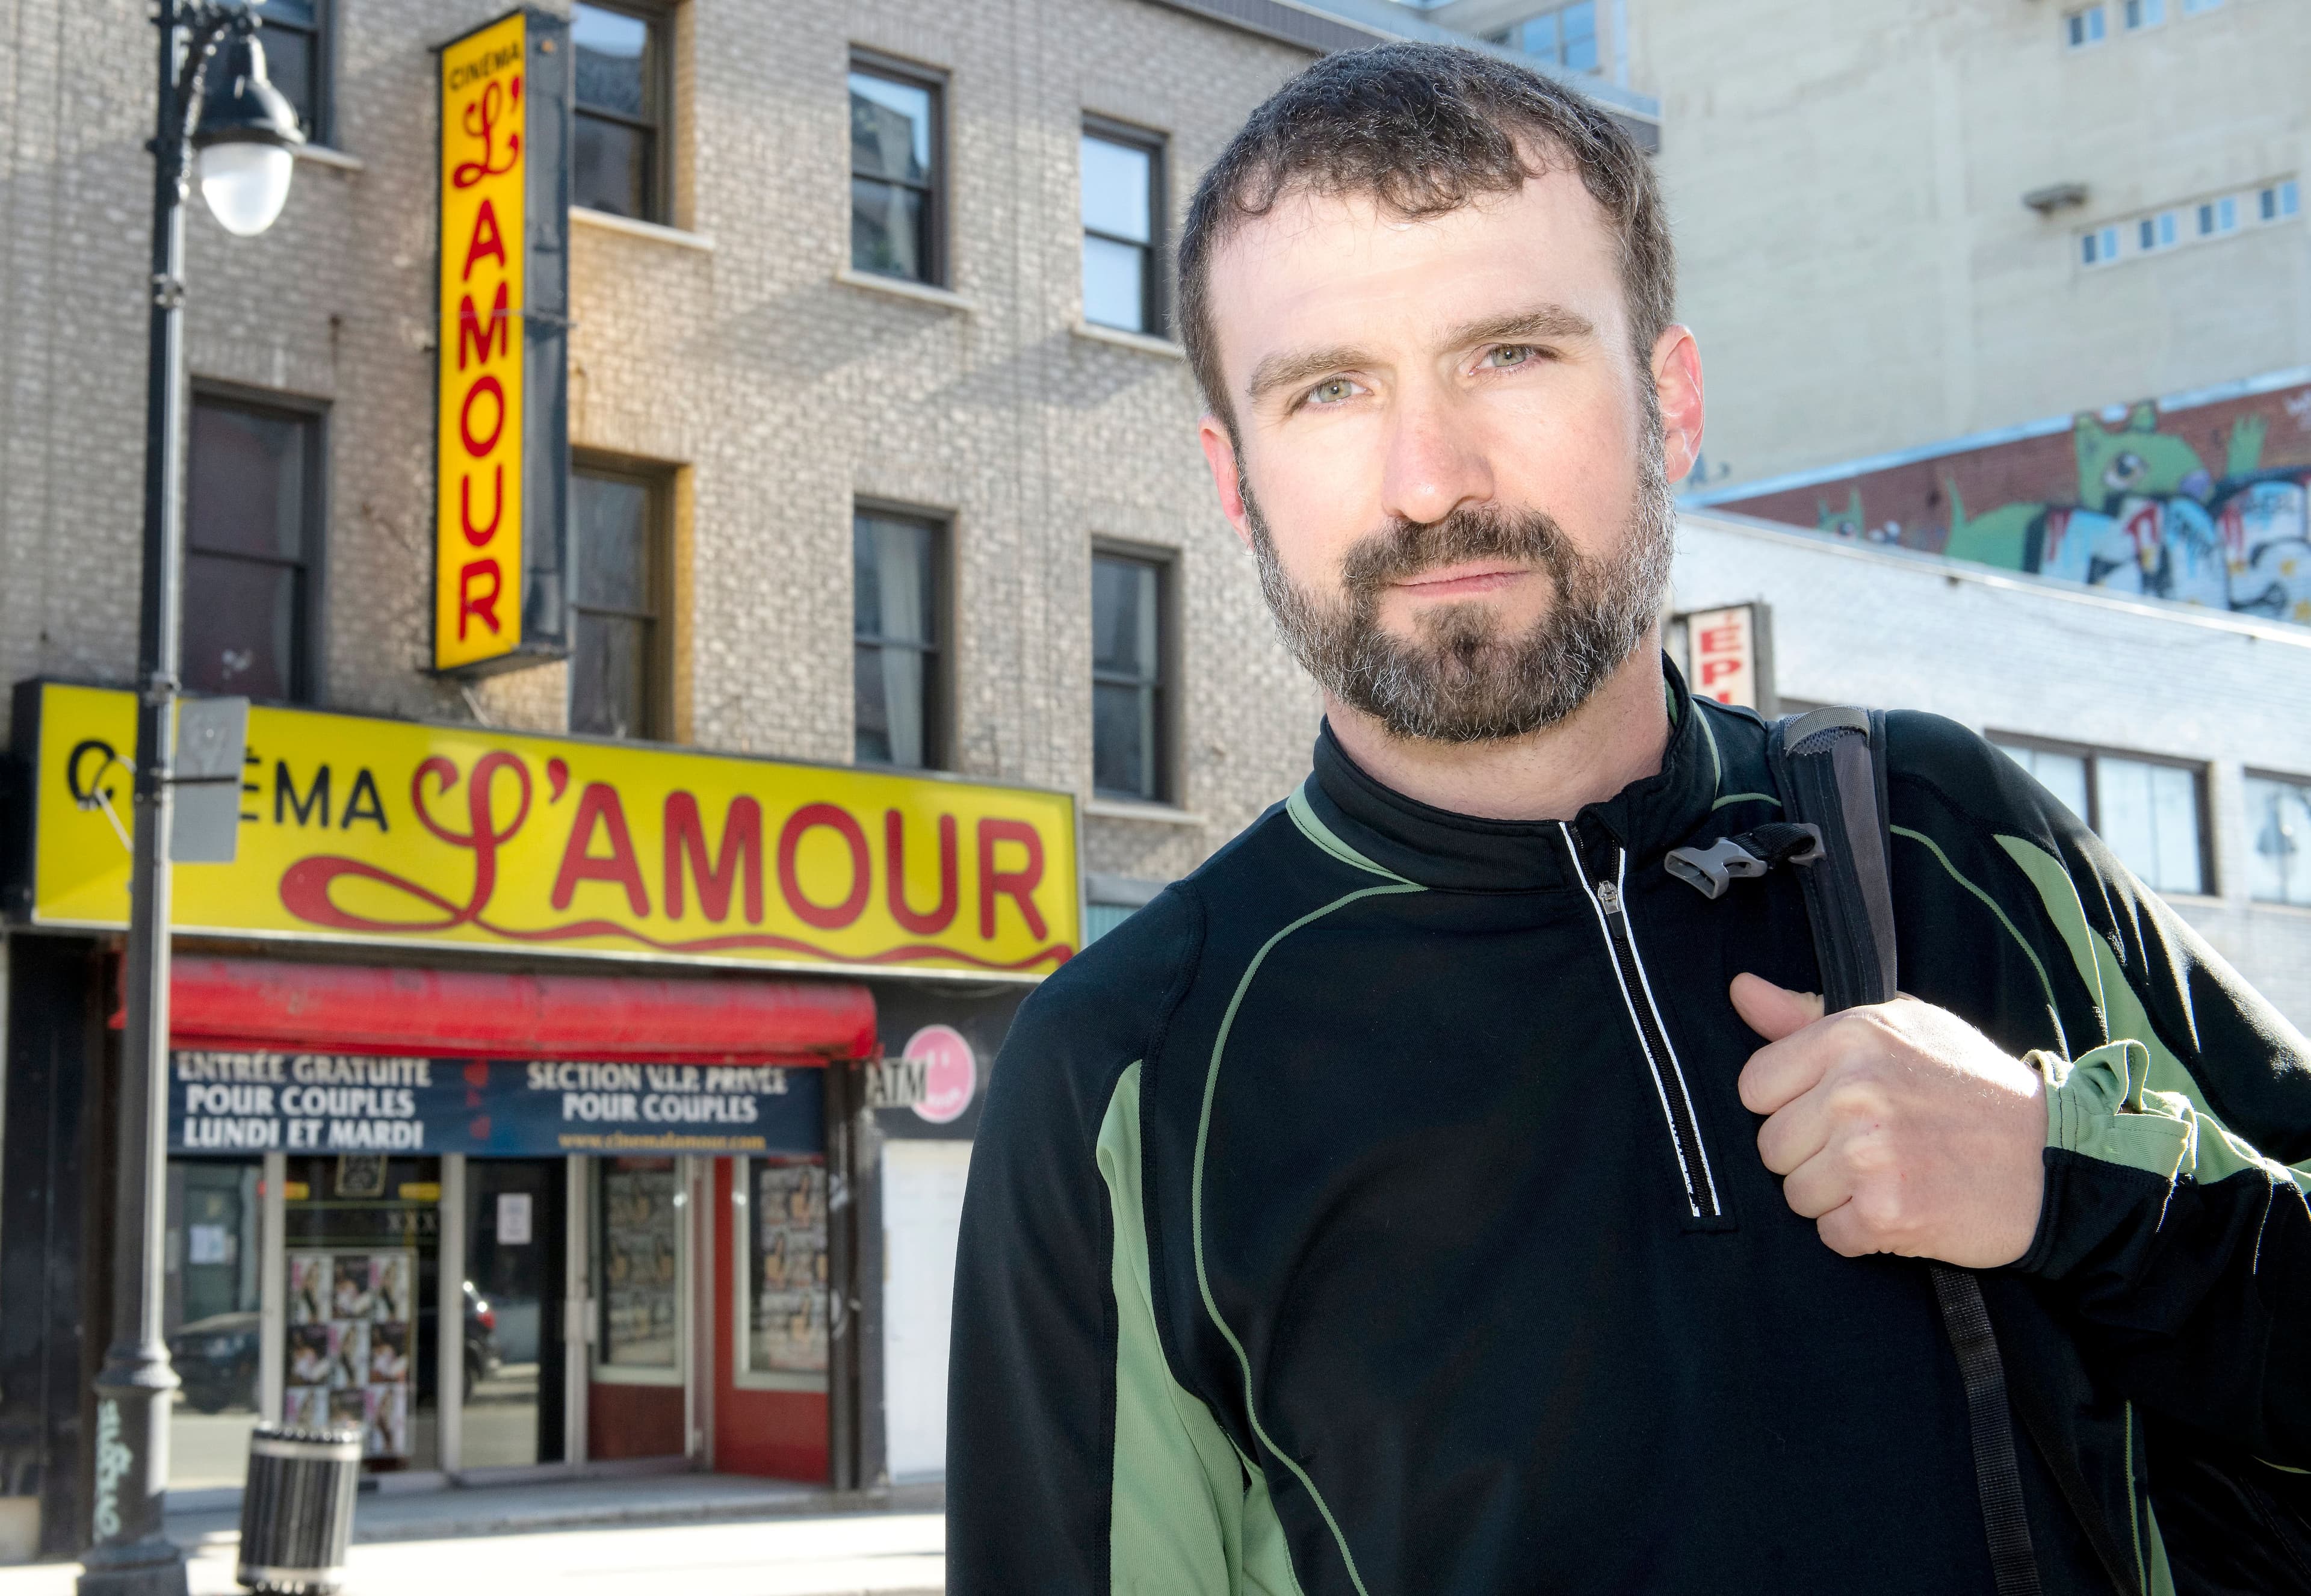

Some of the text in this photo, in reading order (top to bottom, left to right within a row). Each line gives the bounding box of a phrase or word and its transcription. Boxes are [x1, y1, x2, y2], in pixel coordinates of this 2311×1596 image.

[453, 76, 519, 643] L'AMOUR
[280, 750, 1075, 971] L'AMOUR
[178, 1050, 432, 1086] ENTRÉE GRATUITE
[527, 1062, 642, 1092] SECTION
[186, 1084, 416, 1118] POUR COUPLES
[562, 1092, 759, 1124] POUR COUPLES
[184, 1117, 424, 1150] LUNDI ET MARDI
